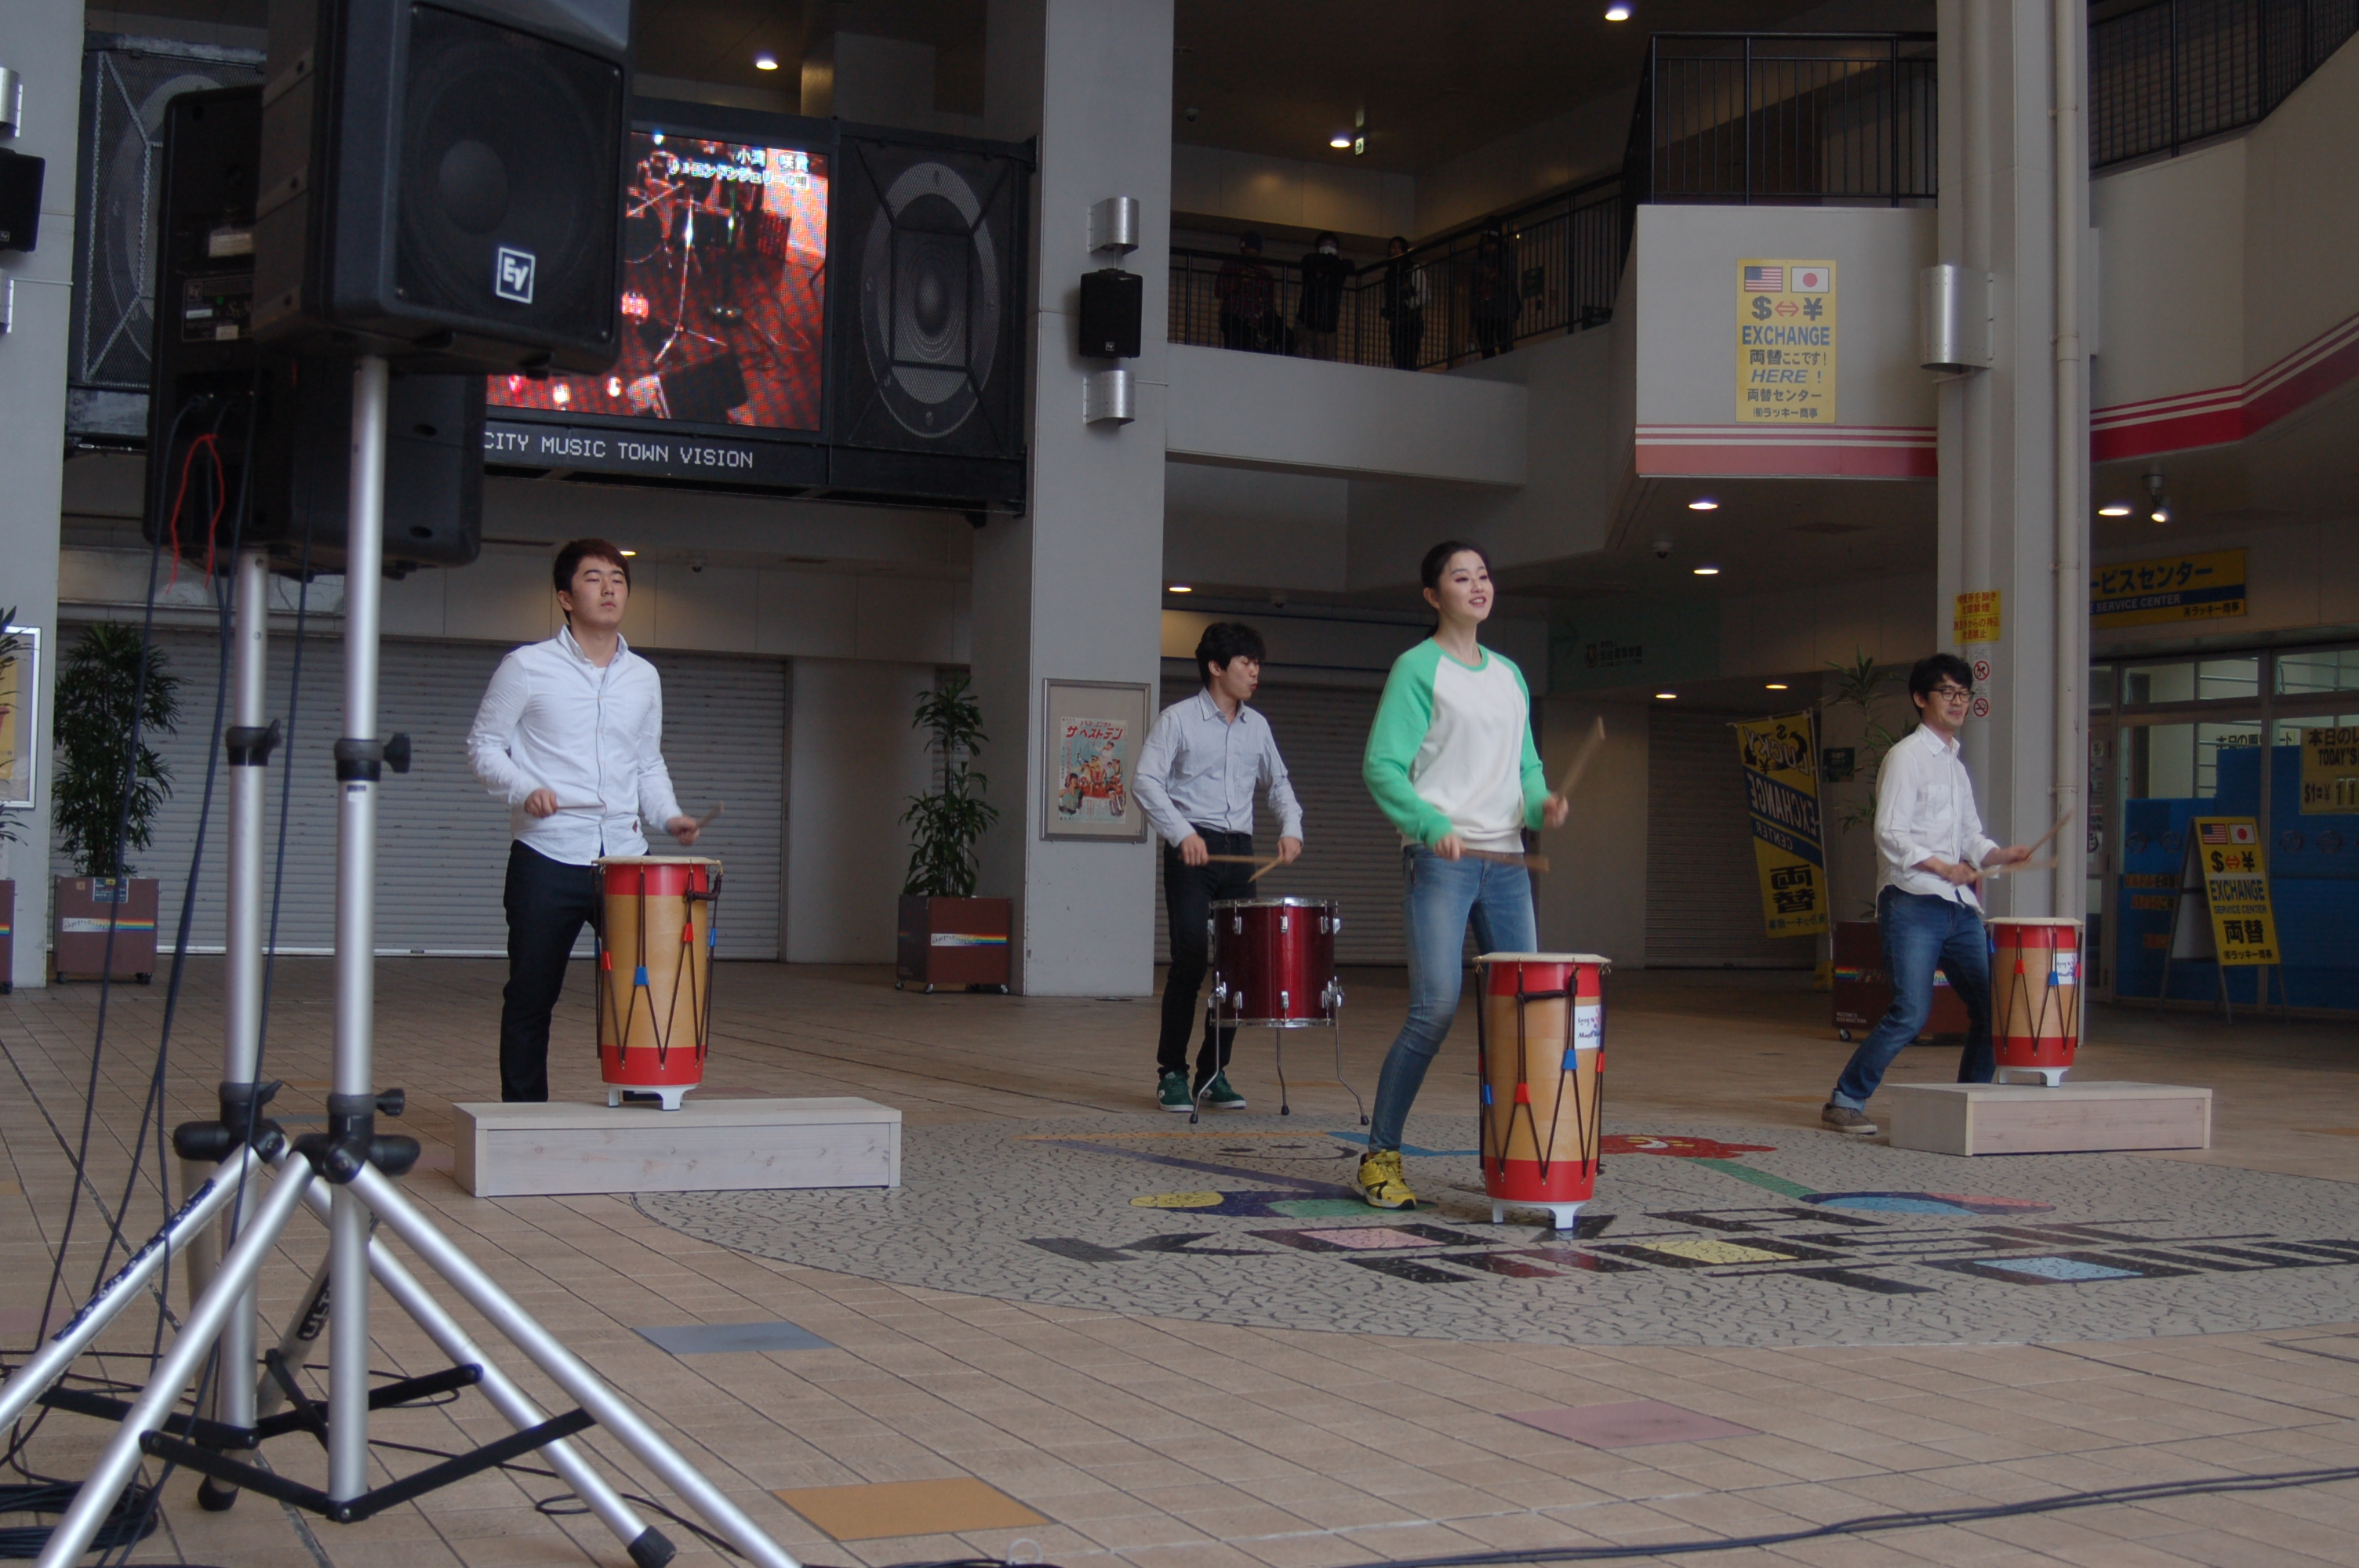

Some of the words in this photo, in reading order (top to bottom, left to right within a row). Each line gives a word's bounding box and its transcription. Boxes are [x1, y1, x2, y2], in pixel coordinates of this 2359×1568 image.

[502, 256, 529, 292] EV
[1750, 295, 1772, 321] $
[1803, 297, 1823, 321] ¥
[1741, 325, 1830, 346] EXCHANGE
[1747, 388, 1823, 403] 両替センター
[541, 436, 606, 459] MUSIC
[617, 441, 670, 463] TOWN
[680, 446, 754, 469] VISION
[2095, 597, 2138, 613] SERVICE
[2140, 593, 2181, 608] CENTER
[2210, 850, 2225, 873] $
[2241, 851, 2255, 873] ¥
[2208, 878, 2266, 902] EXCHANGE
[2213, 904, 2241, 914] SERVICE
[2241, 904, 2267, 914] CENTER
[2223, 919, 2265, 945] 両替
